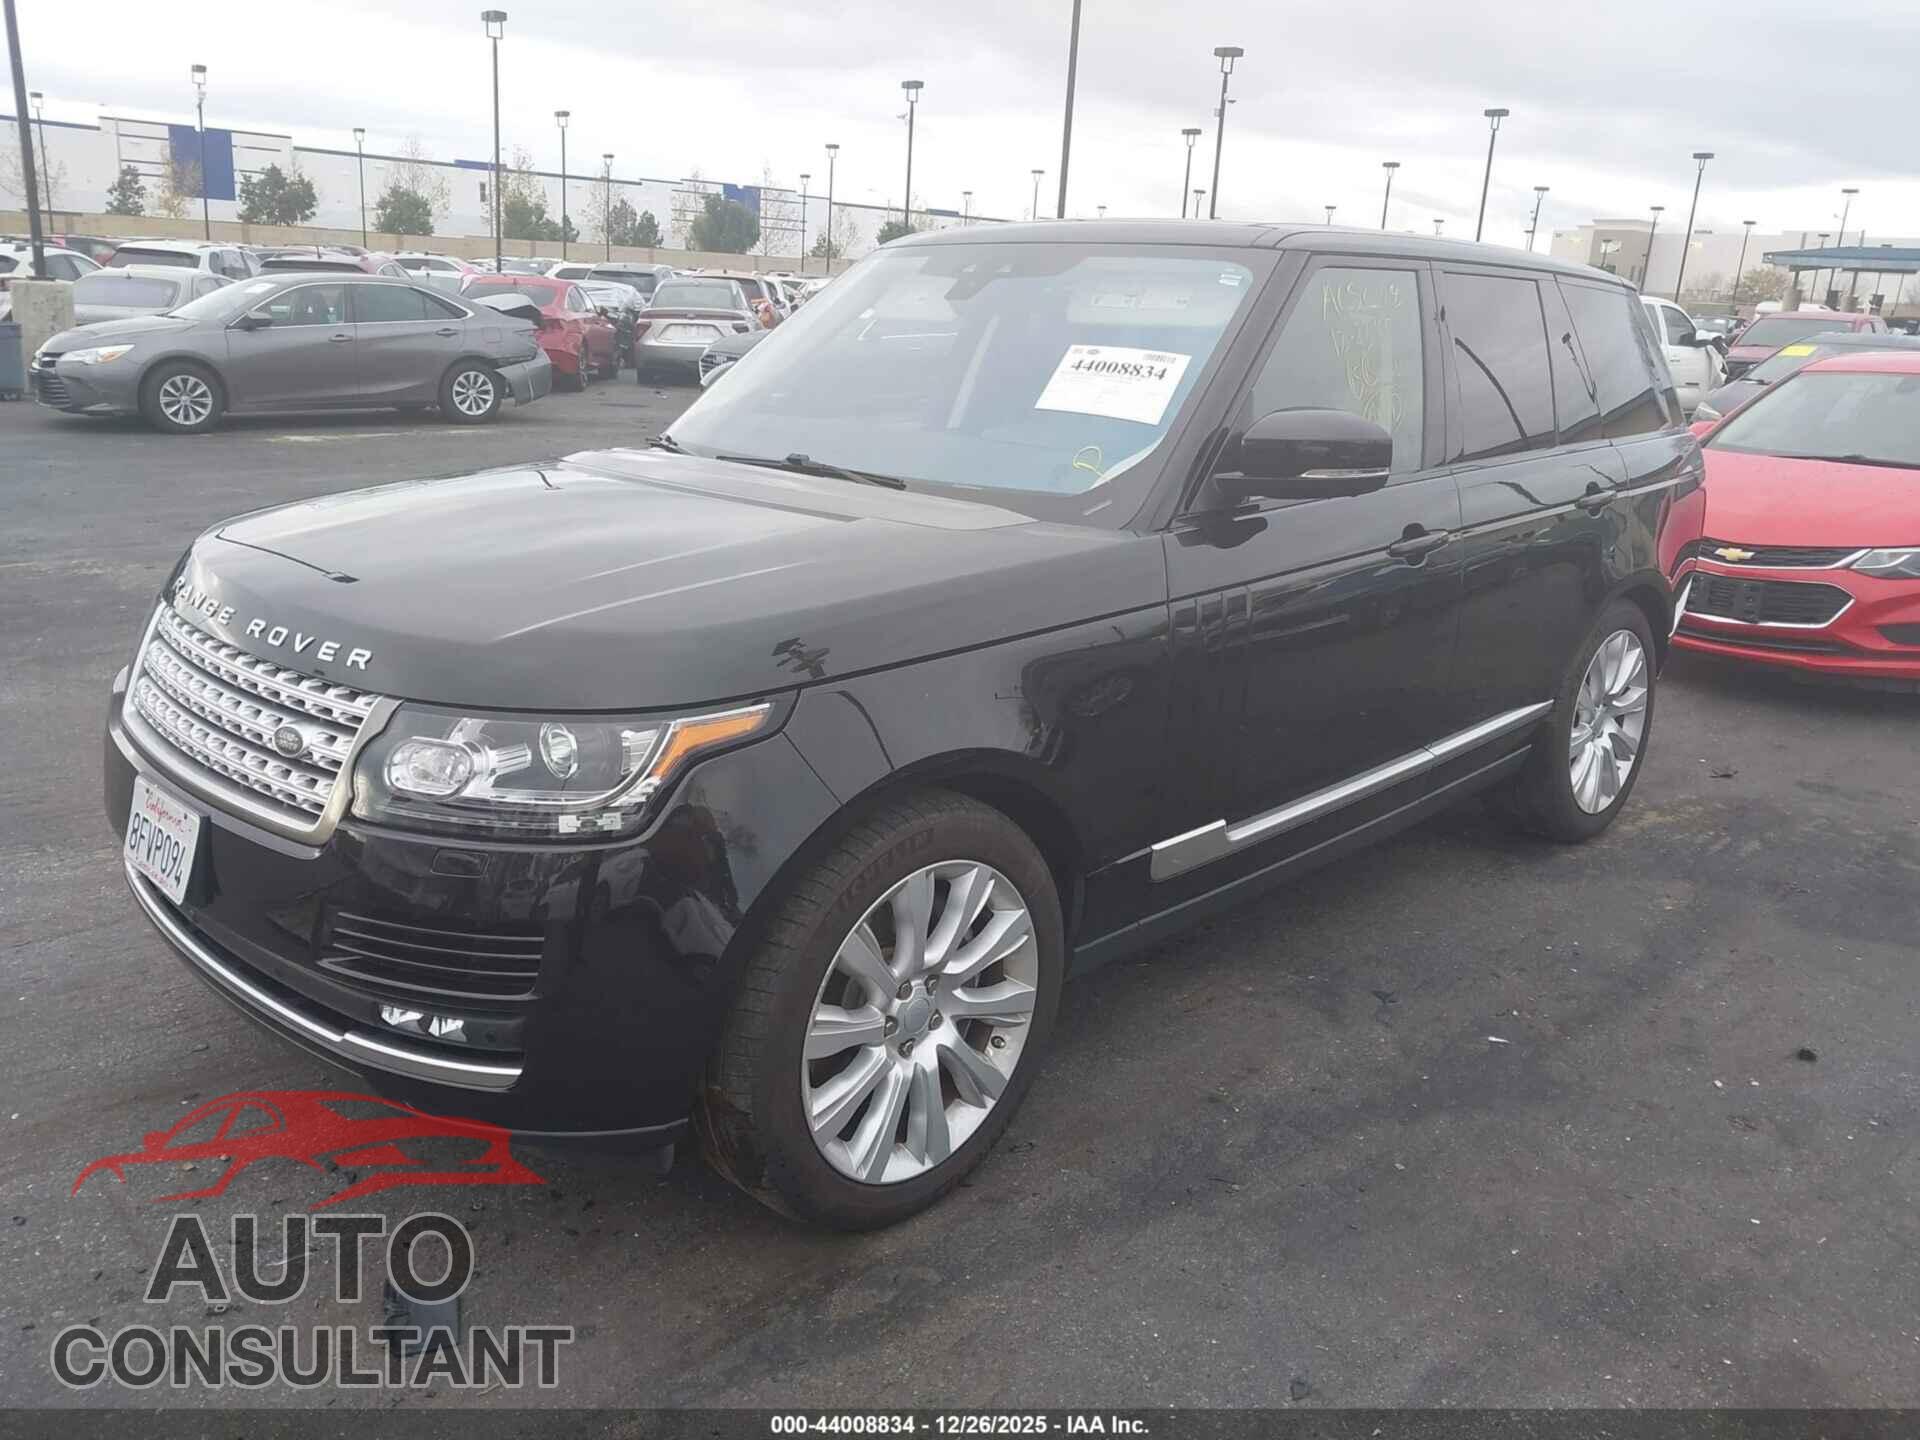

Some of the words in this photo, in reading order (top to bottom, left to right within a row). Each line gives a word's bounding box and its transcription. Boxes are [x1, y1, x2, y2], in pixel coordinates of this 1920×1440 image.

[1071, 359, 1167, 381] 44008834
[173, 576, 236, 625] RANGE
[246, 618, 372, 670] ROVER
[129, 812, 186, 888] 8FVP094
